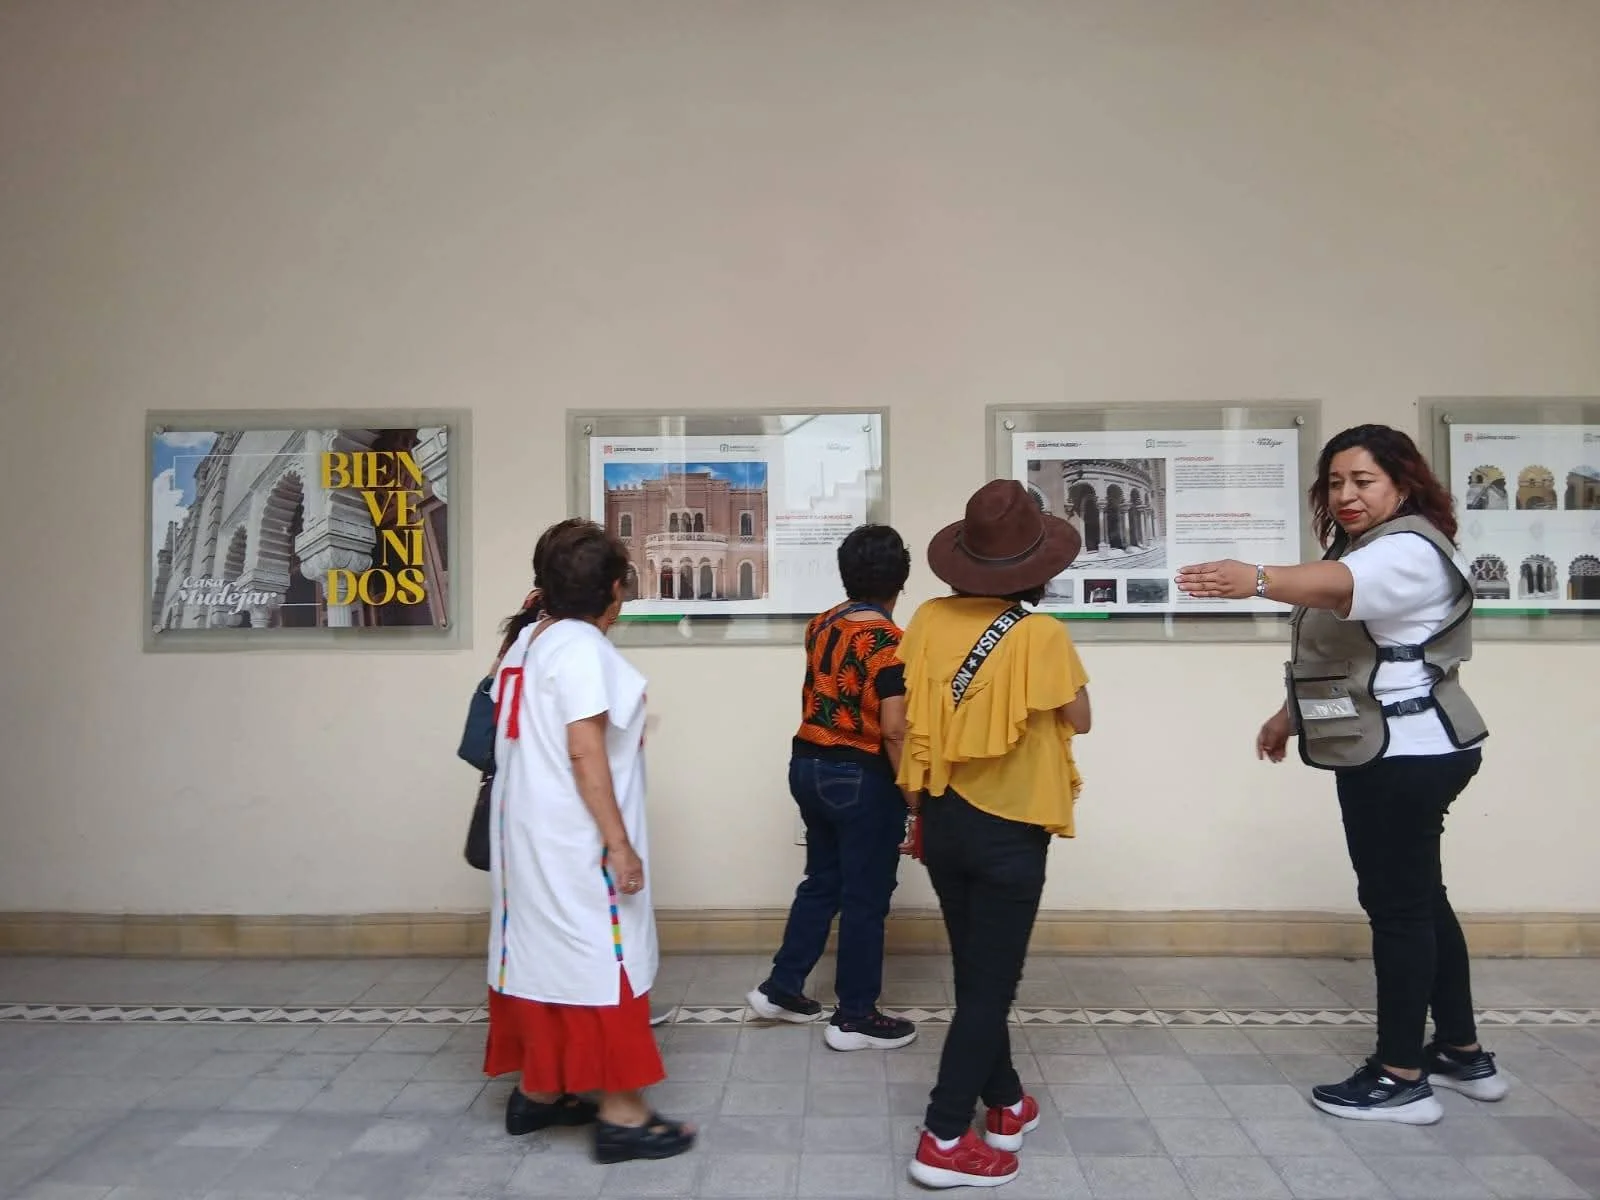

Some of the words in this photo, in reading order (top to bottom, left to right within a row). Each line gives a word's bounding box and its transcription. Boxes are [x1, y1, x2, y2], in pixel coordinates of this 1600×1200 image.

[321, 451, 424, 489] BIEN
[361, 490, 425, 527] VE
[382, 529, 425, 566] NI
[182, 576, 224, 589] Casa
[327, 568, 426, 607] DOS
[993, 611, 1020, 632] LEE
[972, 629, 1001, 657] USA
